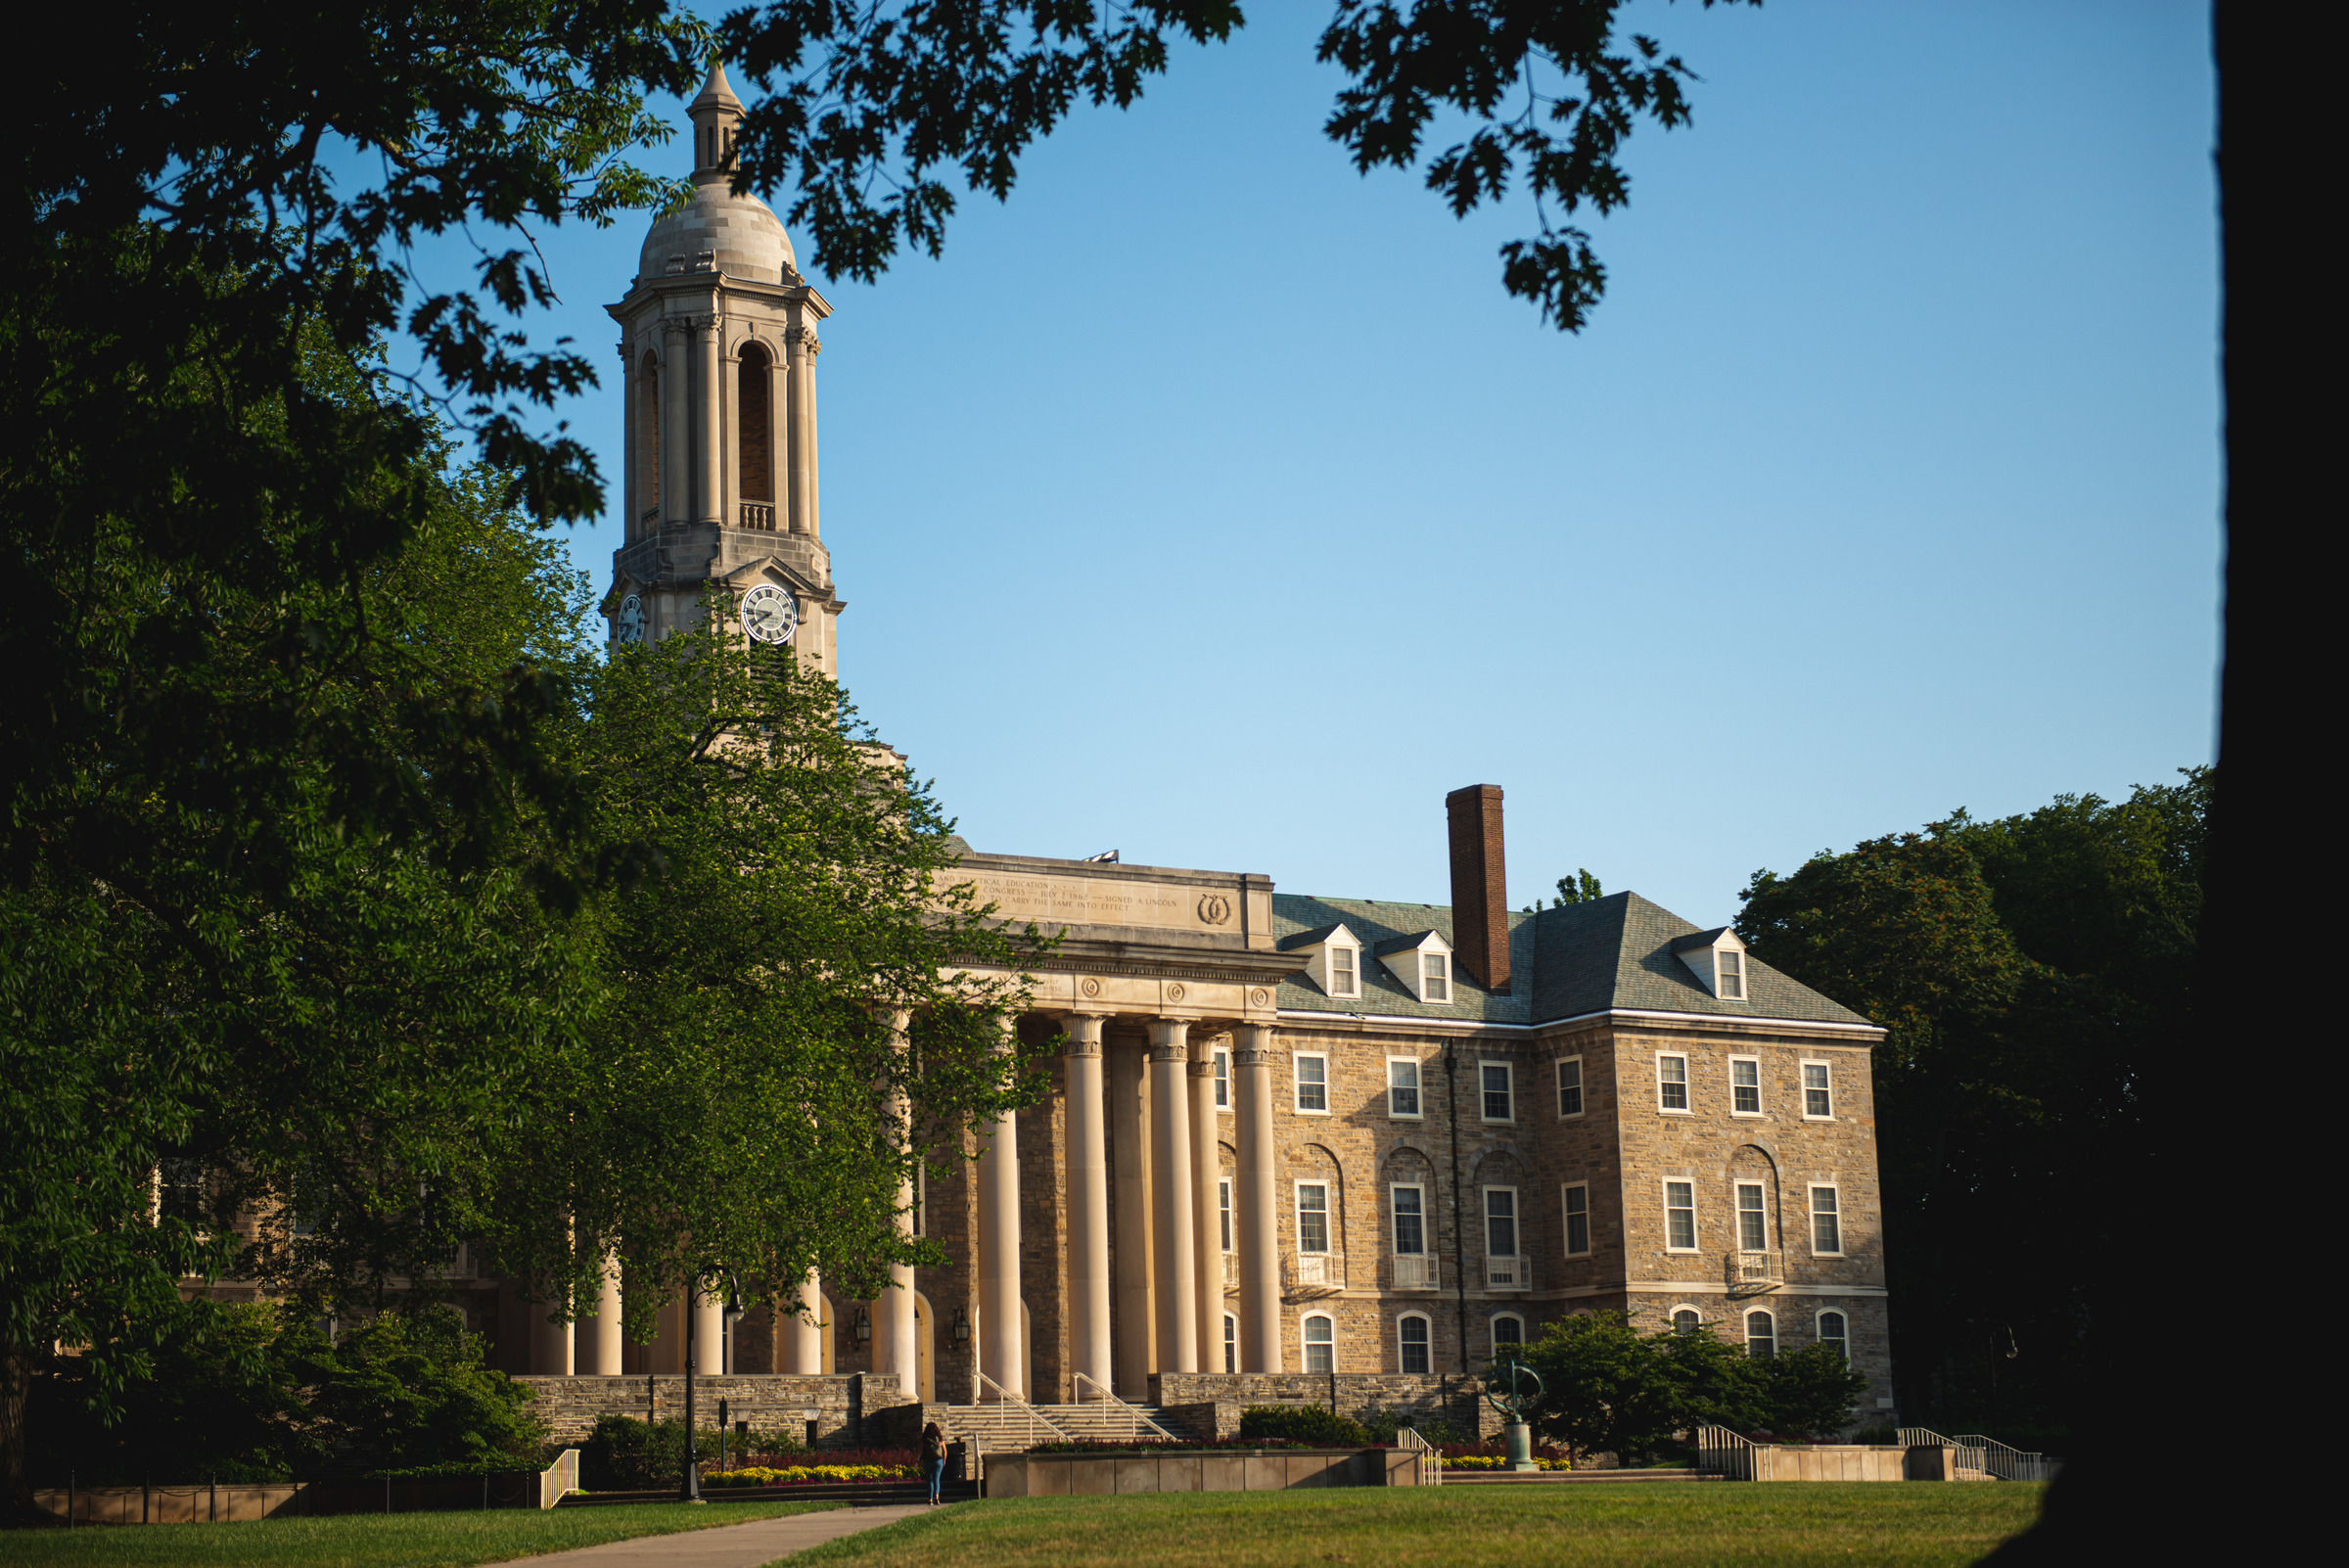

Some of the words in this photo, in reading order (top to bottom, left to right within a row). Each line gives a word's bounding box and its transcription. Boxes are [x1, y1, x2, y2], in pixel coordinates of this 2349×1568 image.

[1006, 879, 1048, 890] EDUCATION
[983, 886, 1026, 896] CONGRESS
[1040, 890, 1057, 899] JULY
[1105, 895, 1133, 903] SIGNED
[1005, 896, 1031, 904] CARRY
[1034, 898, 1048, 906] THE
[1051, 899, 1074, 908] SAME
[1100, 902, 1129, 911] EFFECT
